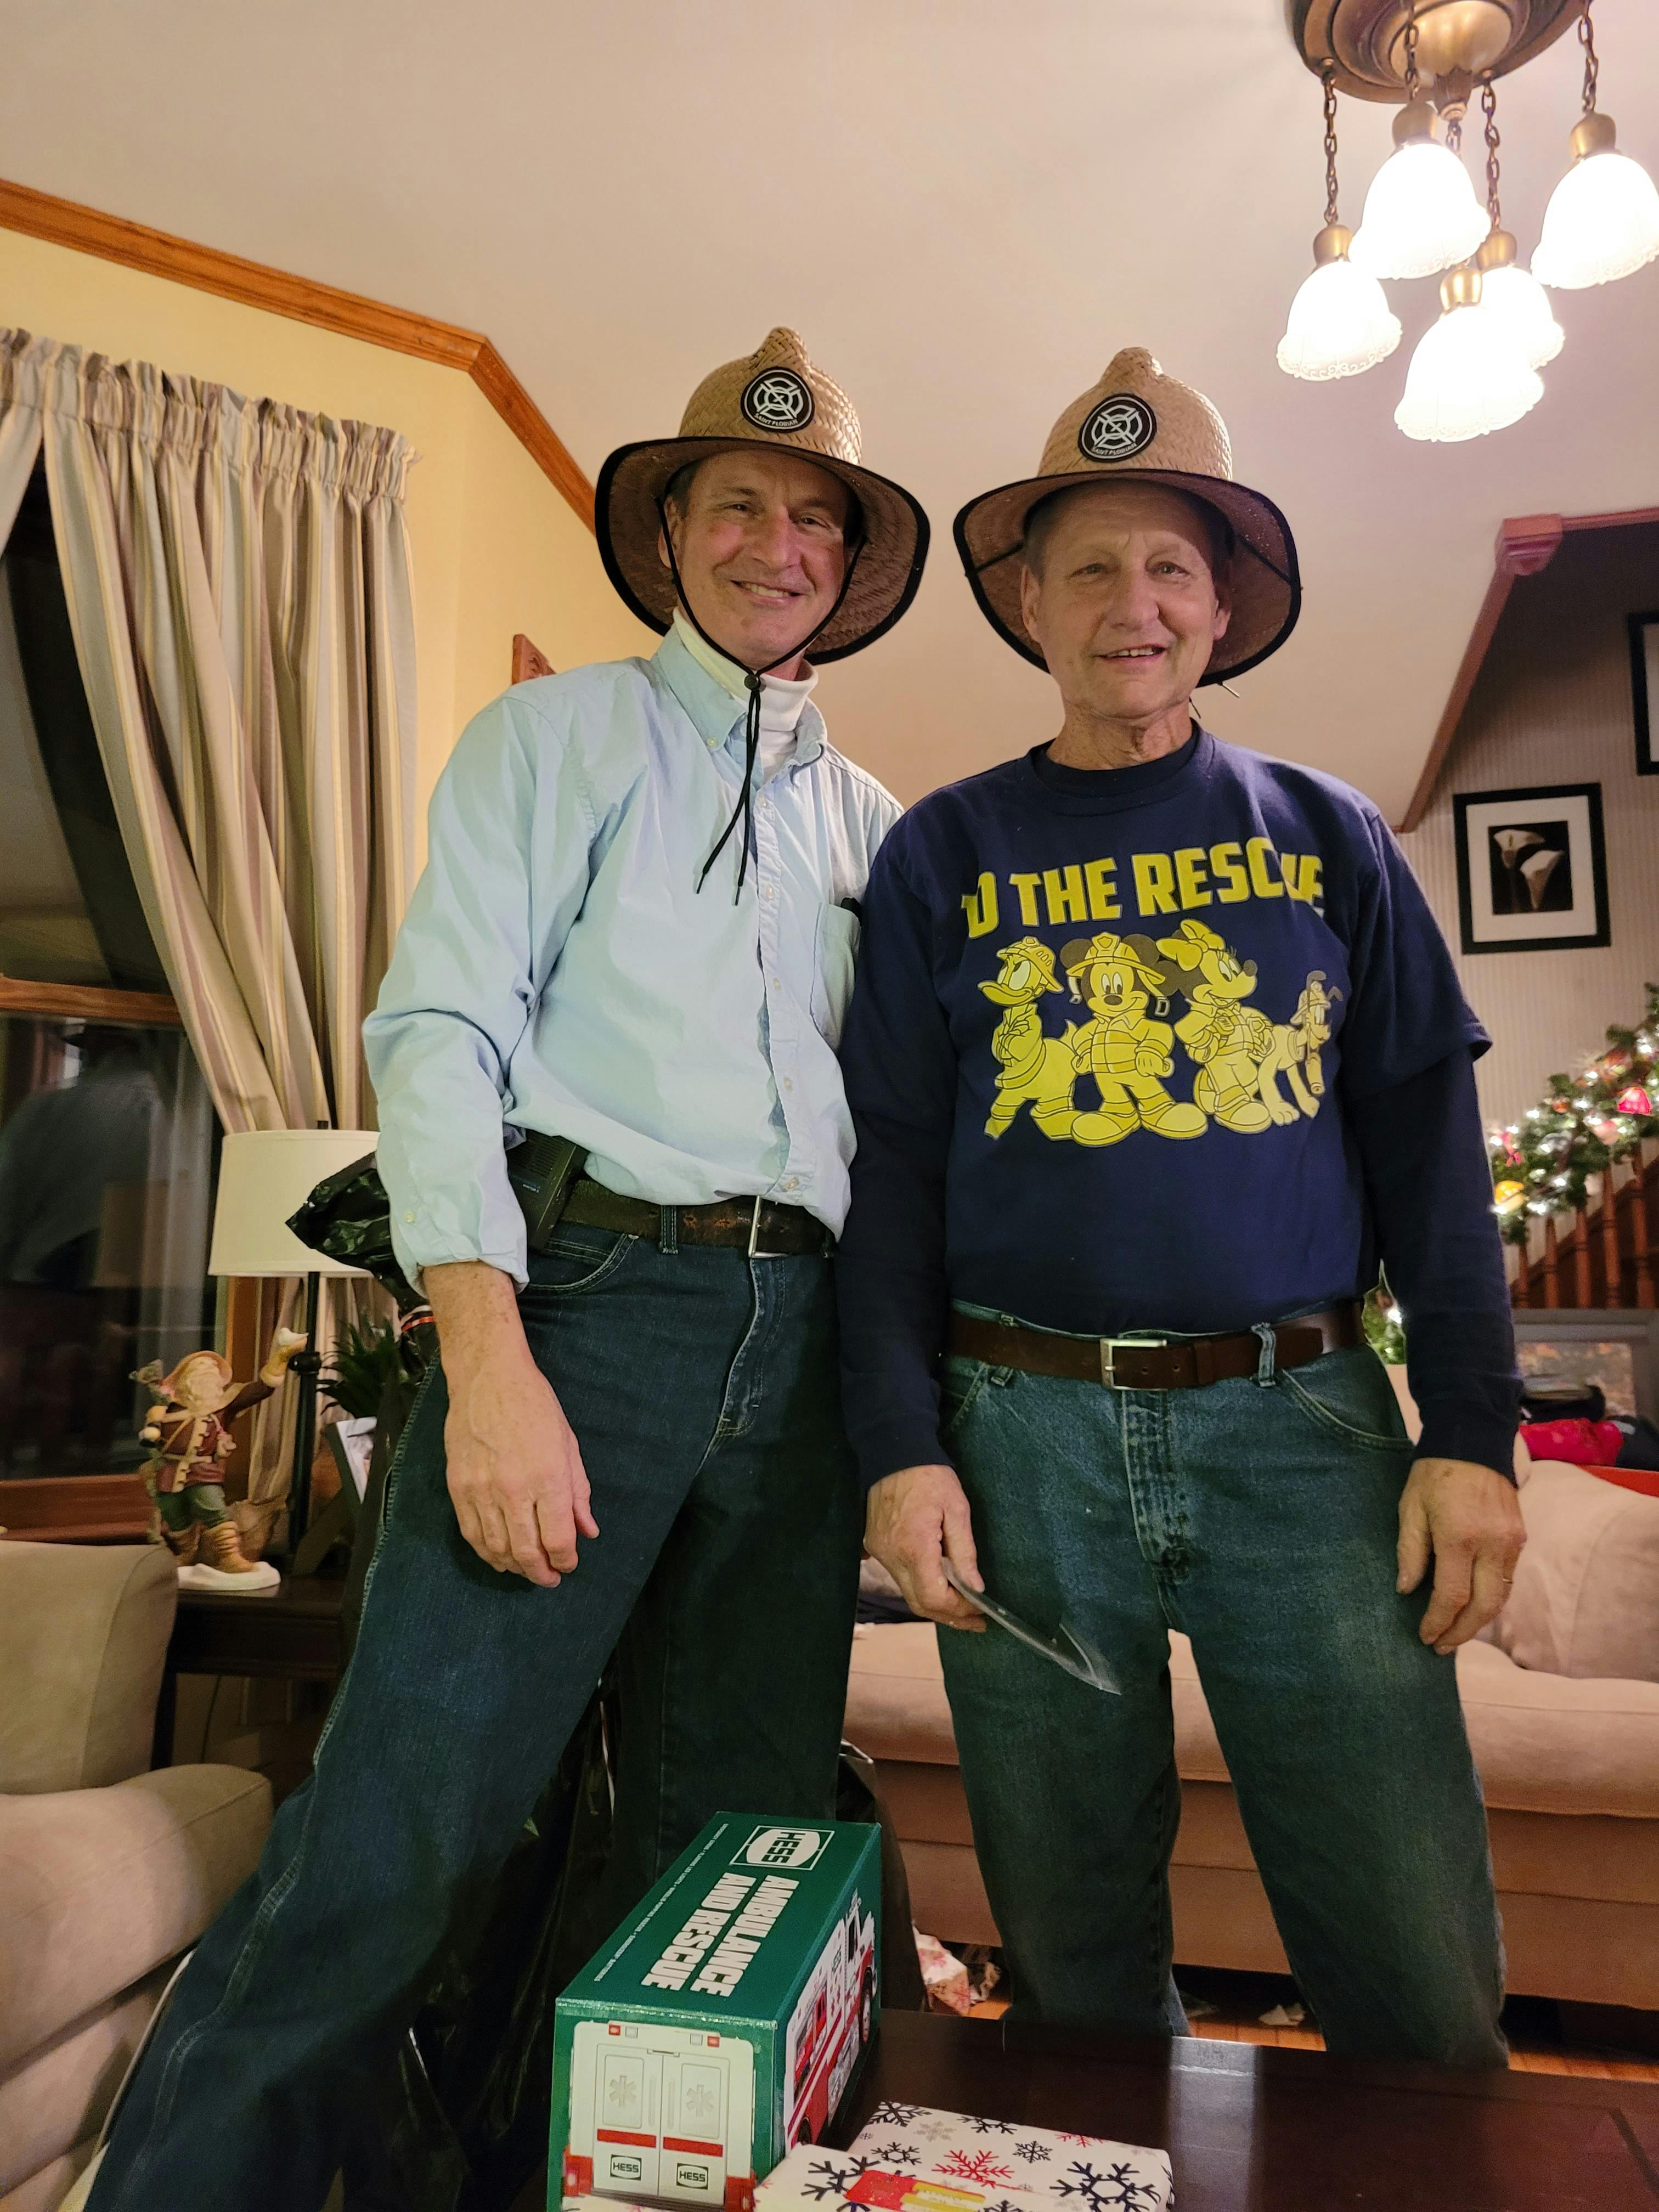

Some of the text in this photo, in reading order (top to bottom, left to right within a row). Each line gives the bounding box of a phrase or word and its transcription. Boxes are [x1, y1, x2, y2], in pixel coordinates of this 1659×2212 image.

[754, 413, 798, 427] SAINT FLORIAN
[1009, 857, 1122, 927] THE
[761, 1831, 806, 1864] HESS
[641, 1872, 757, 1991] AND RESCUE
[690, 1875, 799, 1997] AMBULANCE
[613, 2162, 639, 2173] HESS
[680, 2170, 706, 2182] HESS
